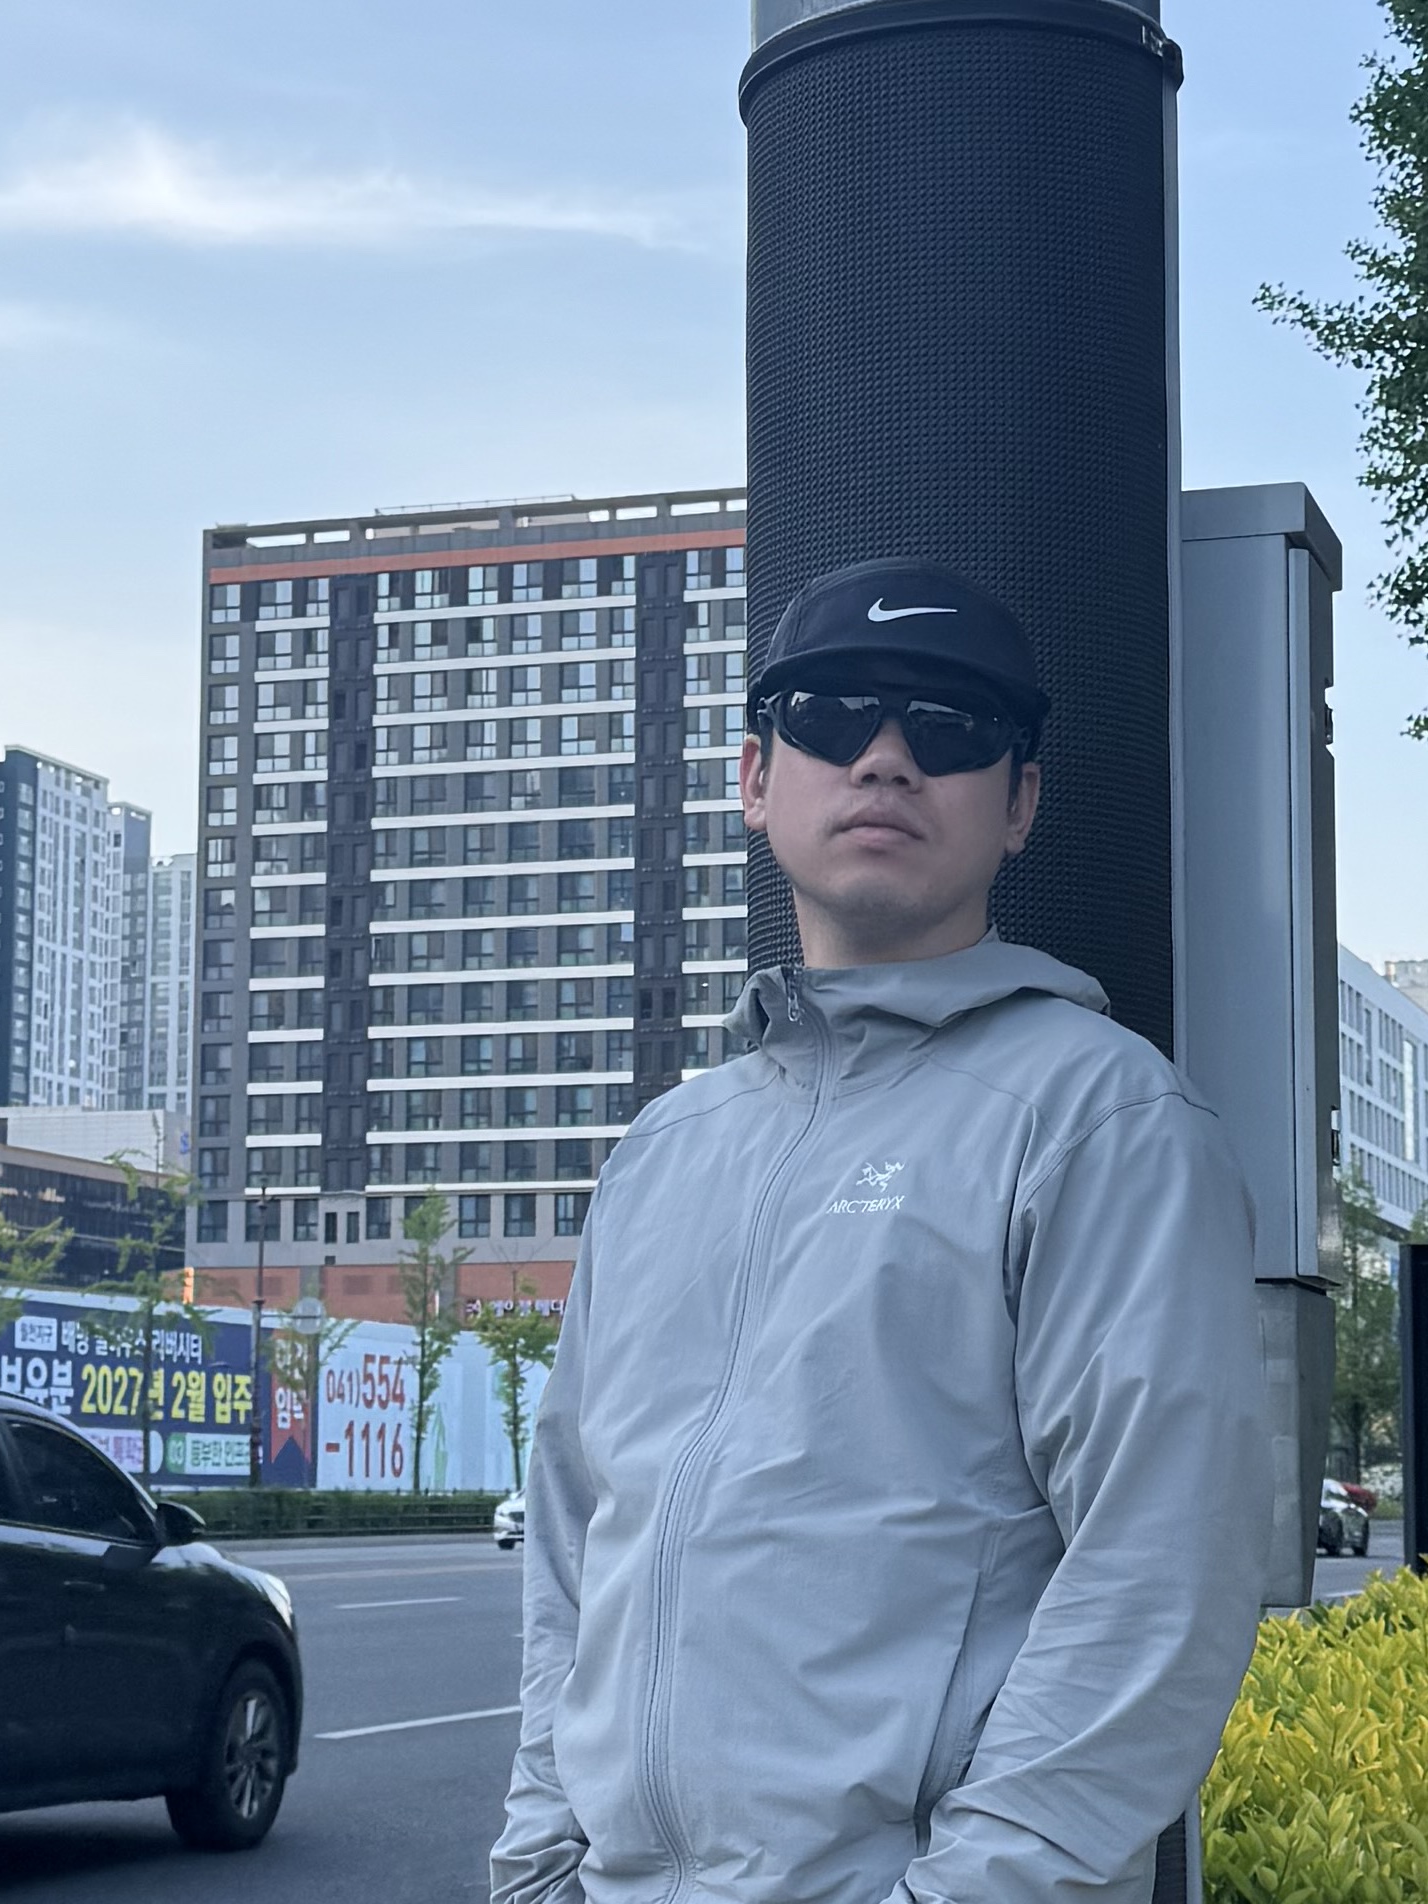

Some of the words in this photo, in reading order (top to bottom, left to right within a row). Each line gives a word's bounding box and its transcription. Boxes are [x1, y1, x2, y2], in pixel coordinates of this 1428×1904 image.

[81, 1363, 165, 1421] 2027년
[172, 1370, 206, 1423] 2월
[213, 1373, 253, 1424] 입주
[327, 1354, 405, 1410] 041)554
[326, 1419, 404, 1478] -1116
